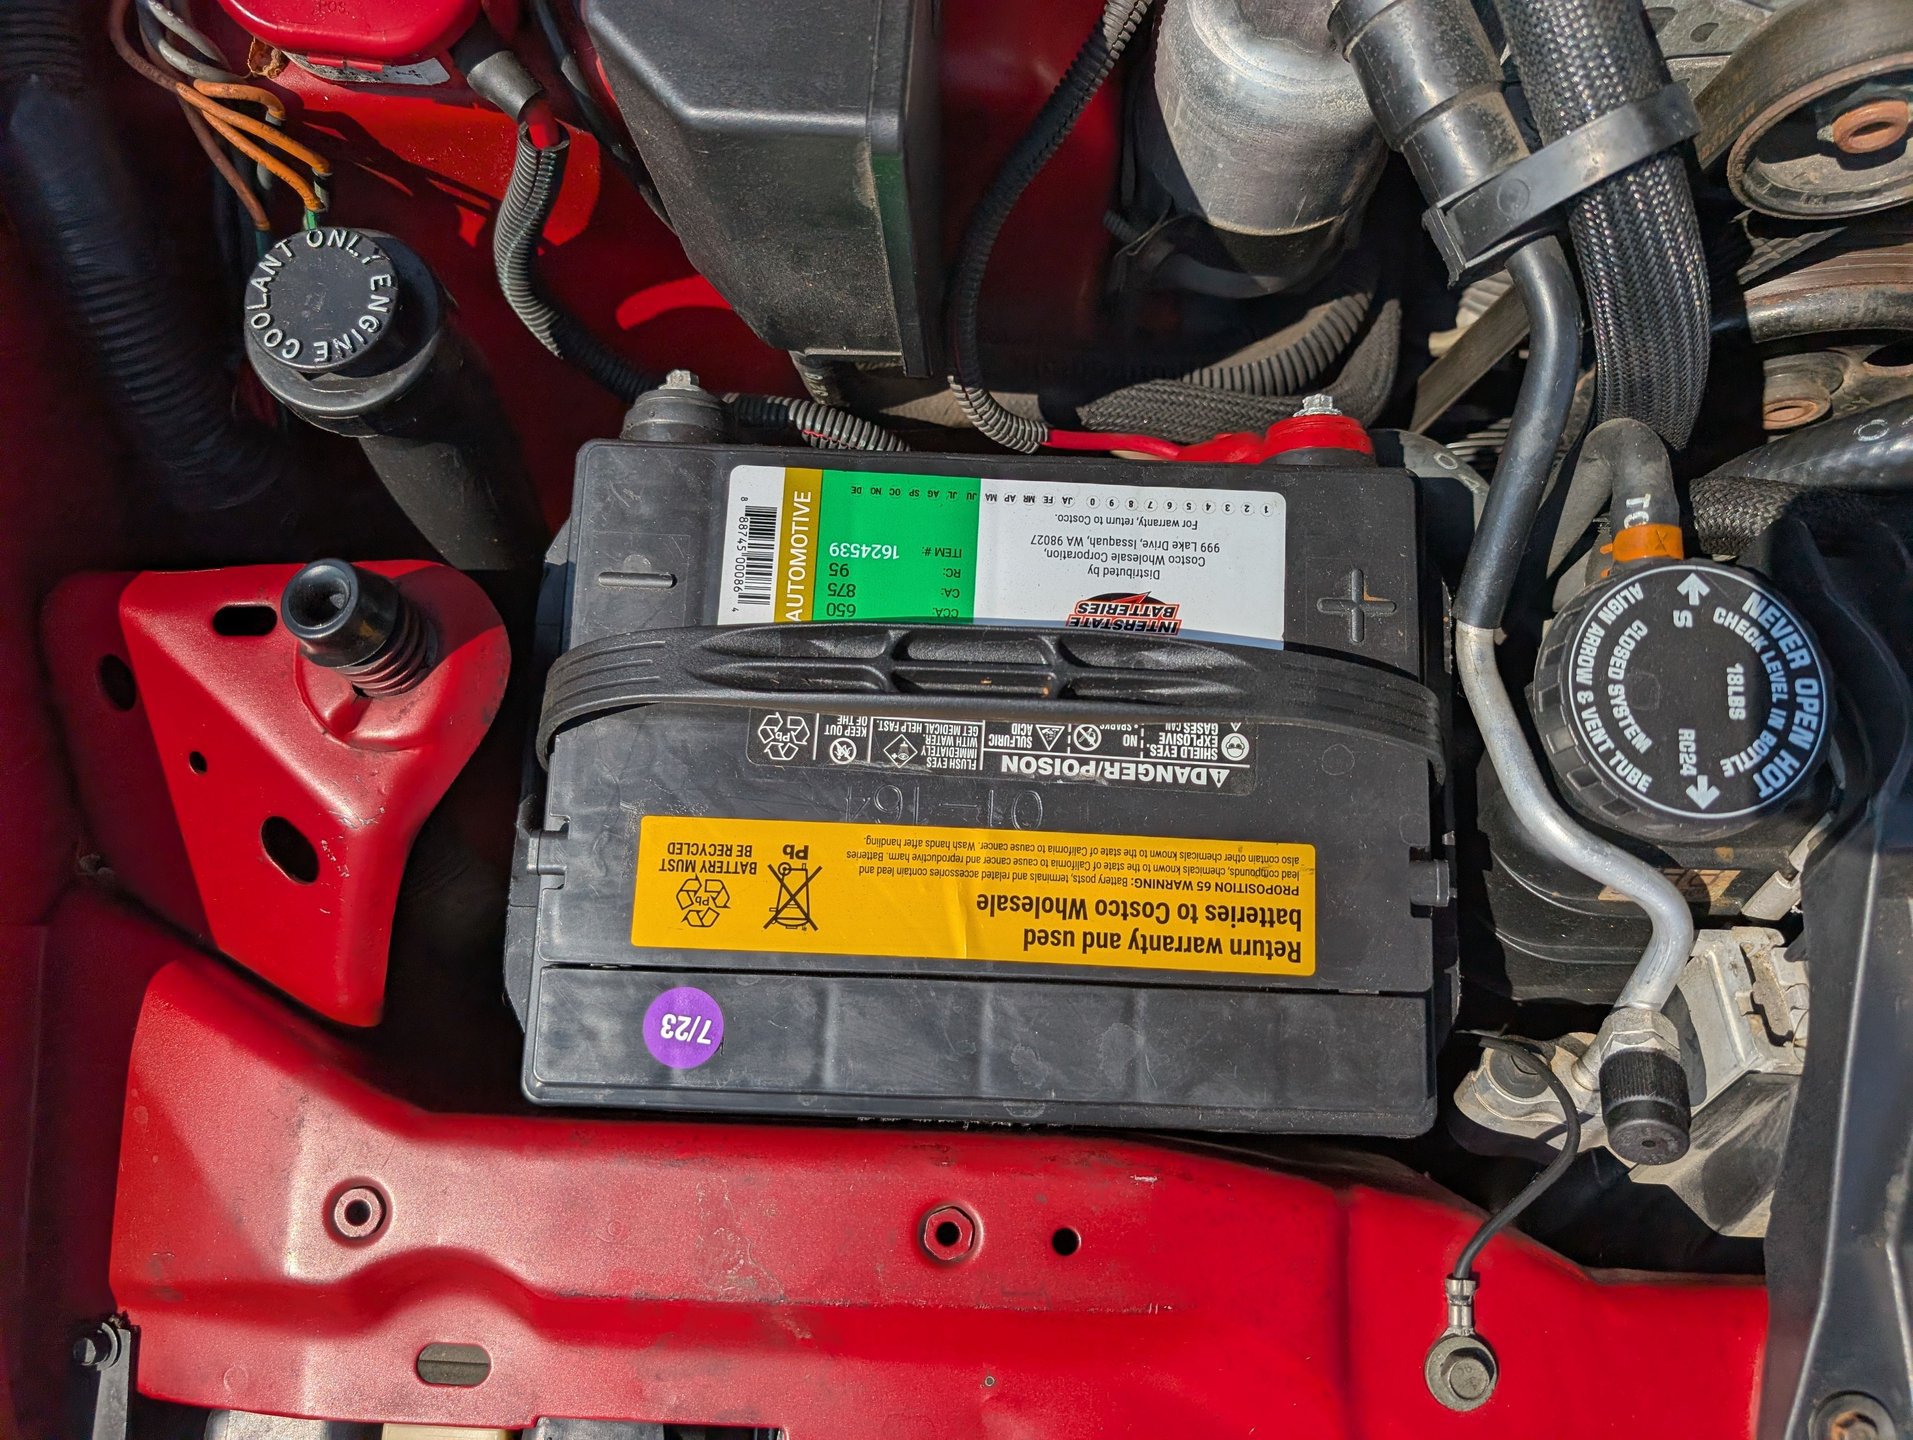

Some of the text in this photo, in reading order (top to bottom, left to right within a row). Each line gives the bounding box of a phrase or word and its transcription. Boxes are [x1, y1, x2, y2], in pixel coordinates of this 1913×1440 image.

[306, 229, 390, 264] ONLY
[246, 239, 301, 359] COOLANT
[313, 273, 392, 362] ENGINE
[870, 487, 882, 495] NO
[889, 488, 901, 496] OC
[908, 489, 920, 497] SP
[927, 490, 939, 498] AG
[947, 491, 958, 500] JL
[966, 492, 977, 500] JU
[985, 493, 997, 502] MA
[1004, 494, 1016, 503] AP
[1023, 494, 1035, 504] MR
[1043, 495, 1053, 504] FE
[1062, 495, 1073, 505] JA
[1054, 513, 1198, 530] For warranty, return to Costco.
[829, 542, 962, 559] ITEM 1624539
[1030, 534, 1220, 553] 999 Lake Drive, Issaquah, WA 98027
[733, 516, 749, 593] 88745 00086
[785, 490, 811, 622] AUTOMOTIVE
[1043, 548, 1206, 567] Costco Wholesale Corporation,
[829, 562, 961, 578] RC: 95
[1087, 564, 1160, 580] Distributed by
[827, 582, 960, 598] CA: 875
[826, 602, 856, 617] 650
[1076, 602, 1176, 618] BATTERIES
[1066, 616, 1179, 634] INTERSTATE
[1673, 610, 1693, 628] S
[1575, 582, 1653, 793] ALIGN ARROW & VENT TUBE
[1607, 620, 1653, 754] CLOSED SYSTEM
[1713, 607, 1788, 778] CHECK LEVEL IN BOTTLE
[1726, 662, 1746, 721] 18LBS
[1742, 591, 1819, 798] NEVER OPEN HOT
[836, 715, 868, 726] OF THE
[876, 719, 979, 737] GET MEDICAL HELP FAST.
[1011, 722, 1034, 735] ACID
[1183, 722, 1219, 735] GASES
[824, 724, 867, 737] KEEP OUT
[1158, 731, 1218, 747] EXPLOSIVE
[922, 733, 978, 748] WITH WATER.
[988, 733, 1033, 748] SULFURIC
[1122, 734, 1138, 747] NO
[920, 745, 978, 758] IMMEDIATELY
[1146, 743, 1218, 760] SHIELD EYES.
[1678, 728, 1697, 777] RC24
[926, 756, 977, 770] FLUSH EYES
[1001, 754, 1207, 785] DANGER/POISON
[667, 841, 753, 858] BE RECYCLED
[863, 835, 1300, 866] also contain other chemicals known to the state of California to cause cancer. Wash hands after handling.
[658, 858, 757, 875] BATTERY MUST
[846, 850, 1300, 881] lead compounds, chemicals known to the state of California to cause cancer and reproductive harm. Batteries
[859, 866, 1299, 896] PROPOSITION 65 WARNING: Battery posts, terminals and related accessories contain lead and
[977, 894, 1301, 932] batteries to Costco Wholesale
[1023, 928, 1301, 963] Return warranty and used
[660, 1013, 712, 1045] 7/23
